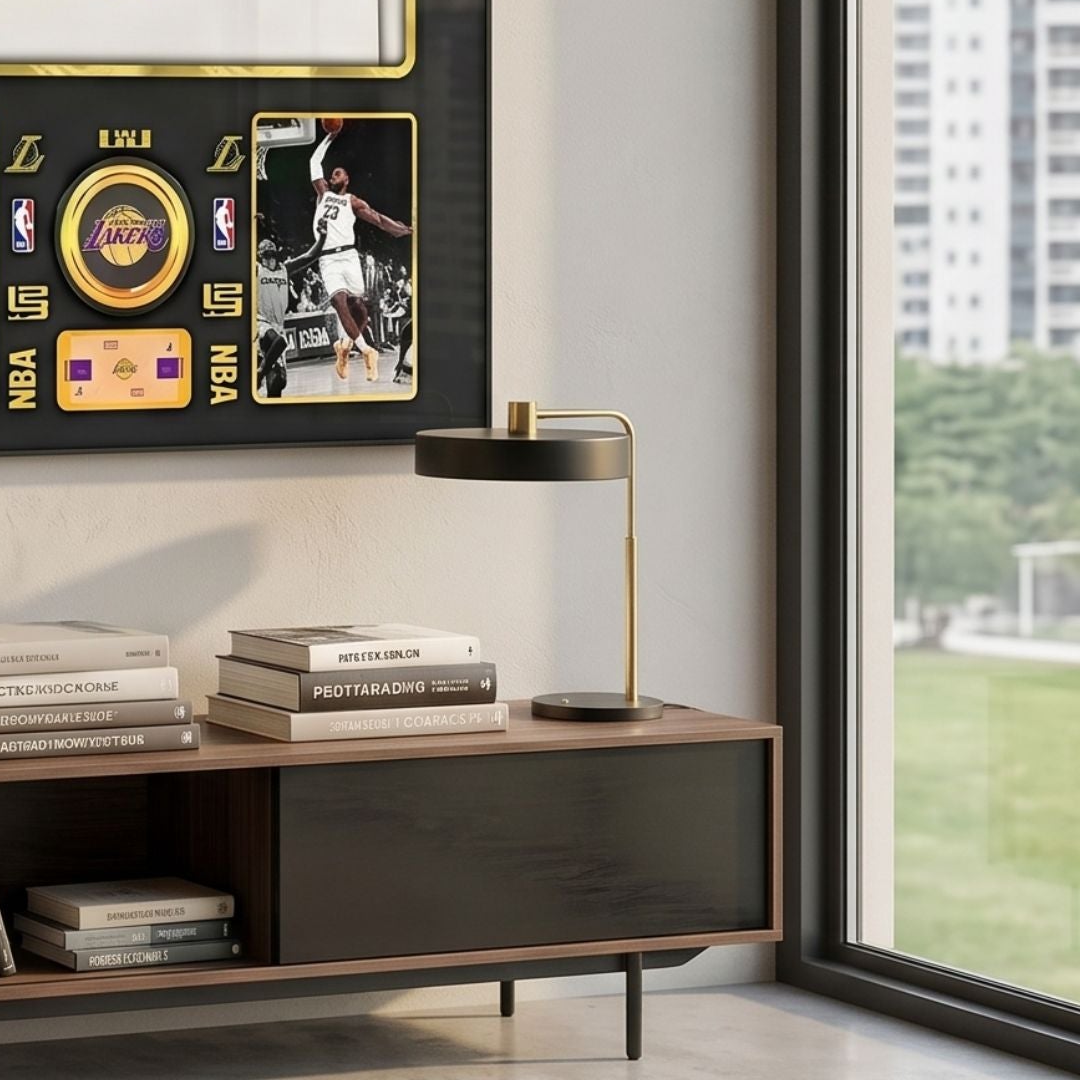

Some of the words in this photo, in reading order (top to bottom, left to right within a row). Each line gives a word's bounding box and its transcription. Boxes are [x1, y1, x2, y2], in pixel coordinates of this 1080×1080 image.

[323, 204, 340, 220] 23
[8, 348, 37, 409] NBA
[210, 344, 238, 405] NBA
